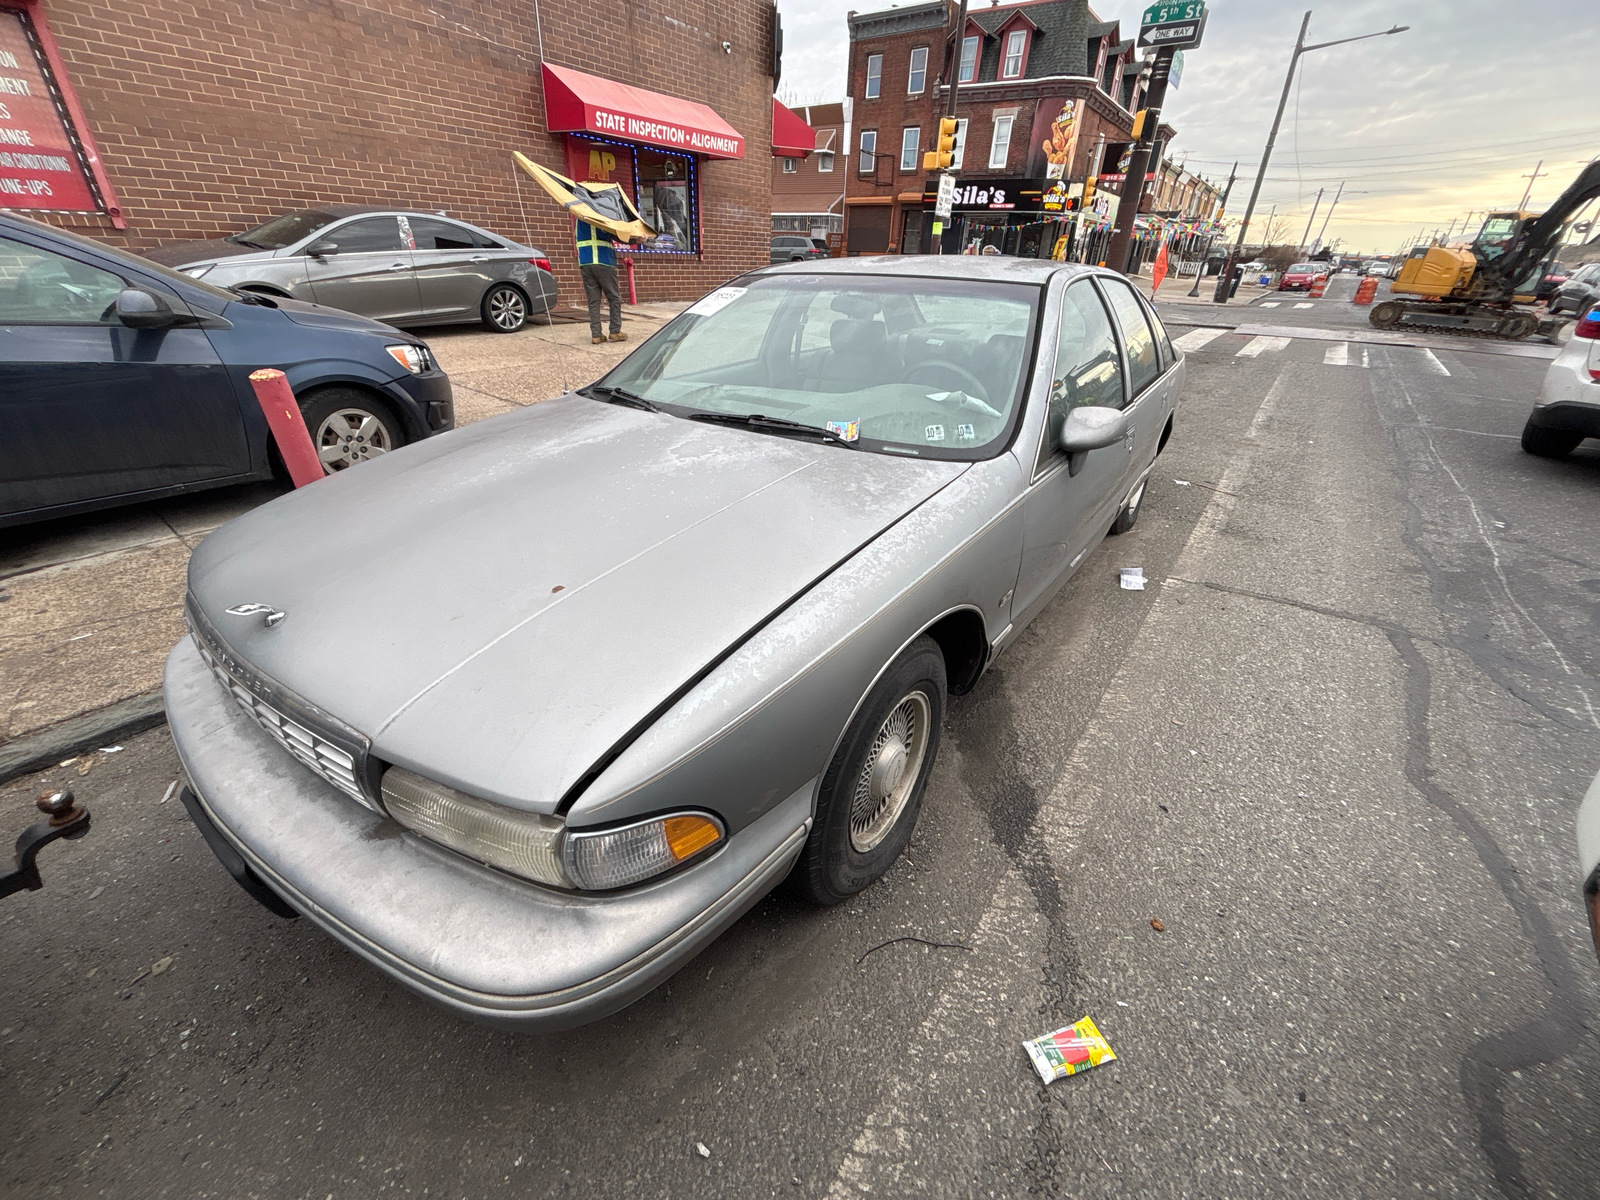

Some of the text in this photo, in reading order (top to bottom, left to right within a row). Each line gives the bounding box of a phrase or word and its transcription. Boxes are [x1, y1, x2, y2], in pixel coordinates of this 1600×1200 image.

[1159, 7, 1180, 22] 5th
[1185, 3, 1202, 18] St
[1155, 27, 1191, 39] ONE WAY
[595, 110, 739, 154] STATE INSPECTION ALIGNMENT
[12, 152, 71, 172] CONDITIONING
[588, 149, 616, 181] AP
[941, 188, 951, 196] TURN
[943, 179, 951, 187] NO
[952, 185, 1006, 205] Sila's
[1042, 193, 1066, 204] Sila's
